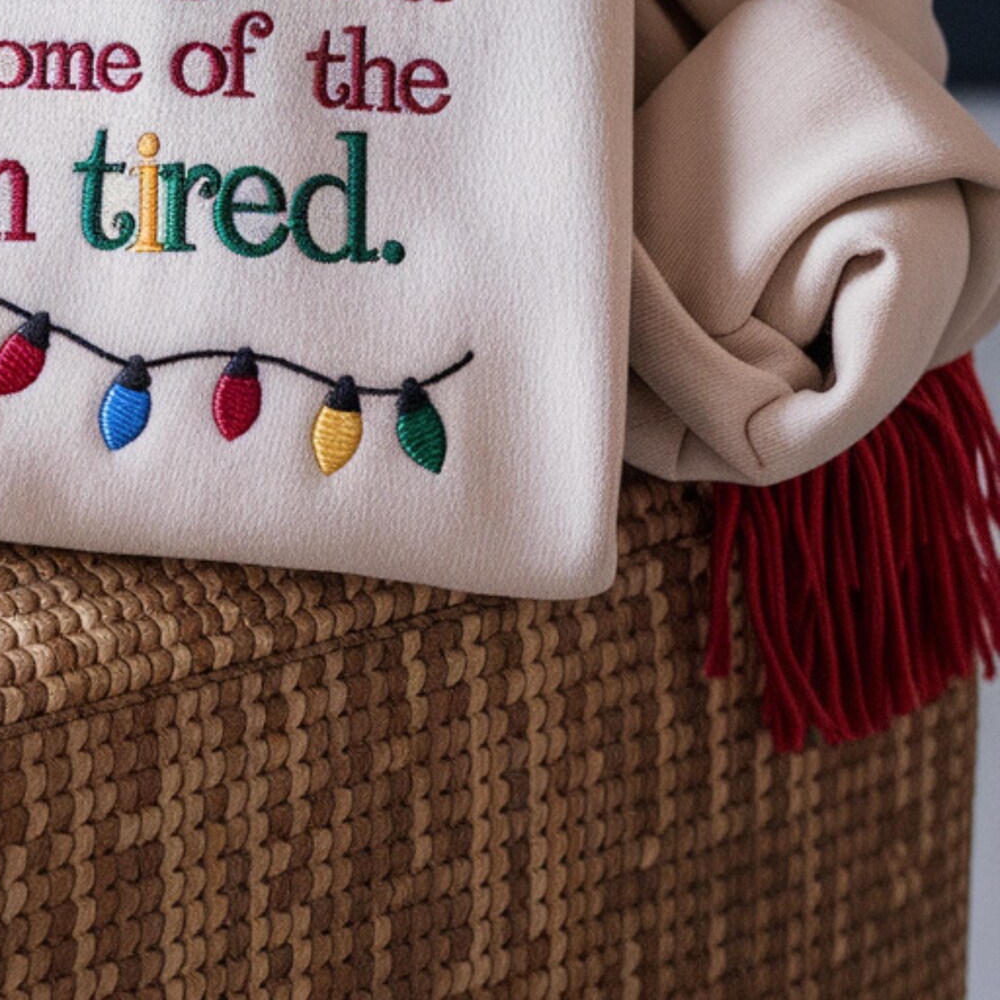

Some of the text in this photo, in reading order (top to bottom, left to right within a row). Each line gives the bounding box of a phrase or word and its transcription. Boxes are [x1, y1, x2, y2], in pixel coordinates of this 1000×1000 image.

[169, 10, 275, 99] of
[305, 25, 452, 116] the
[73, 129, 405, 264] tired.
